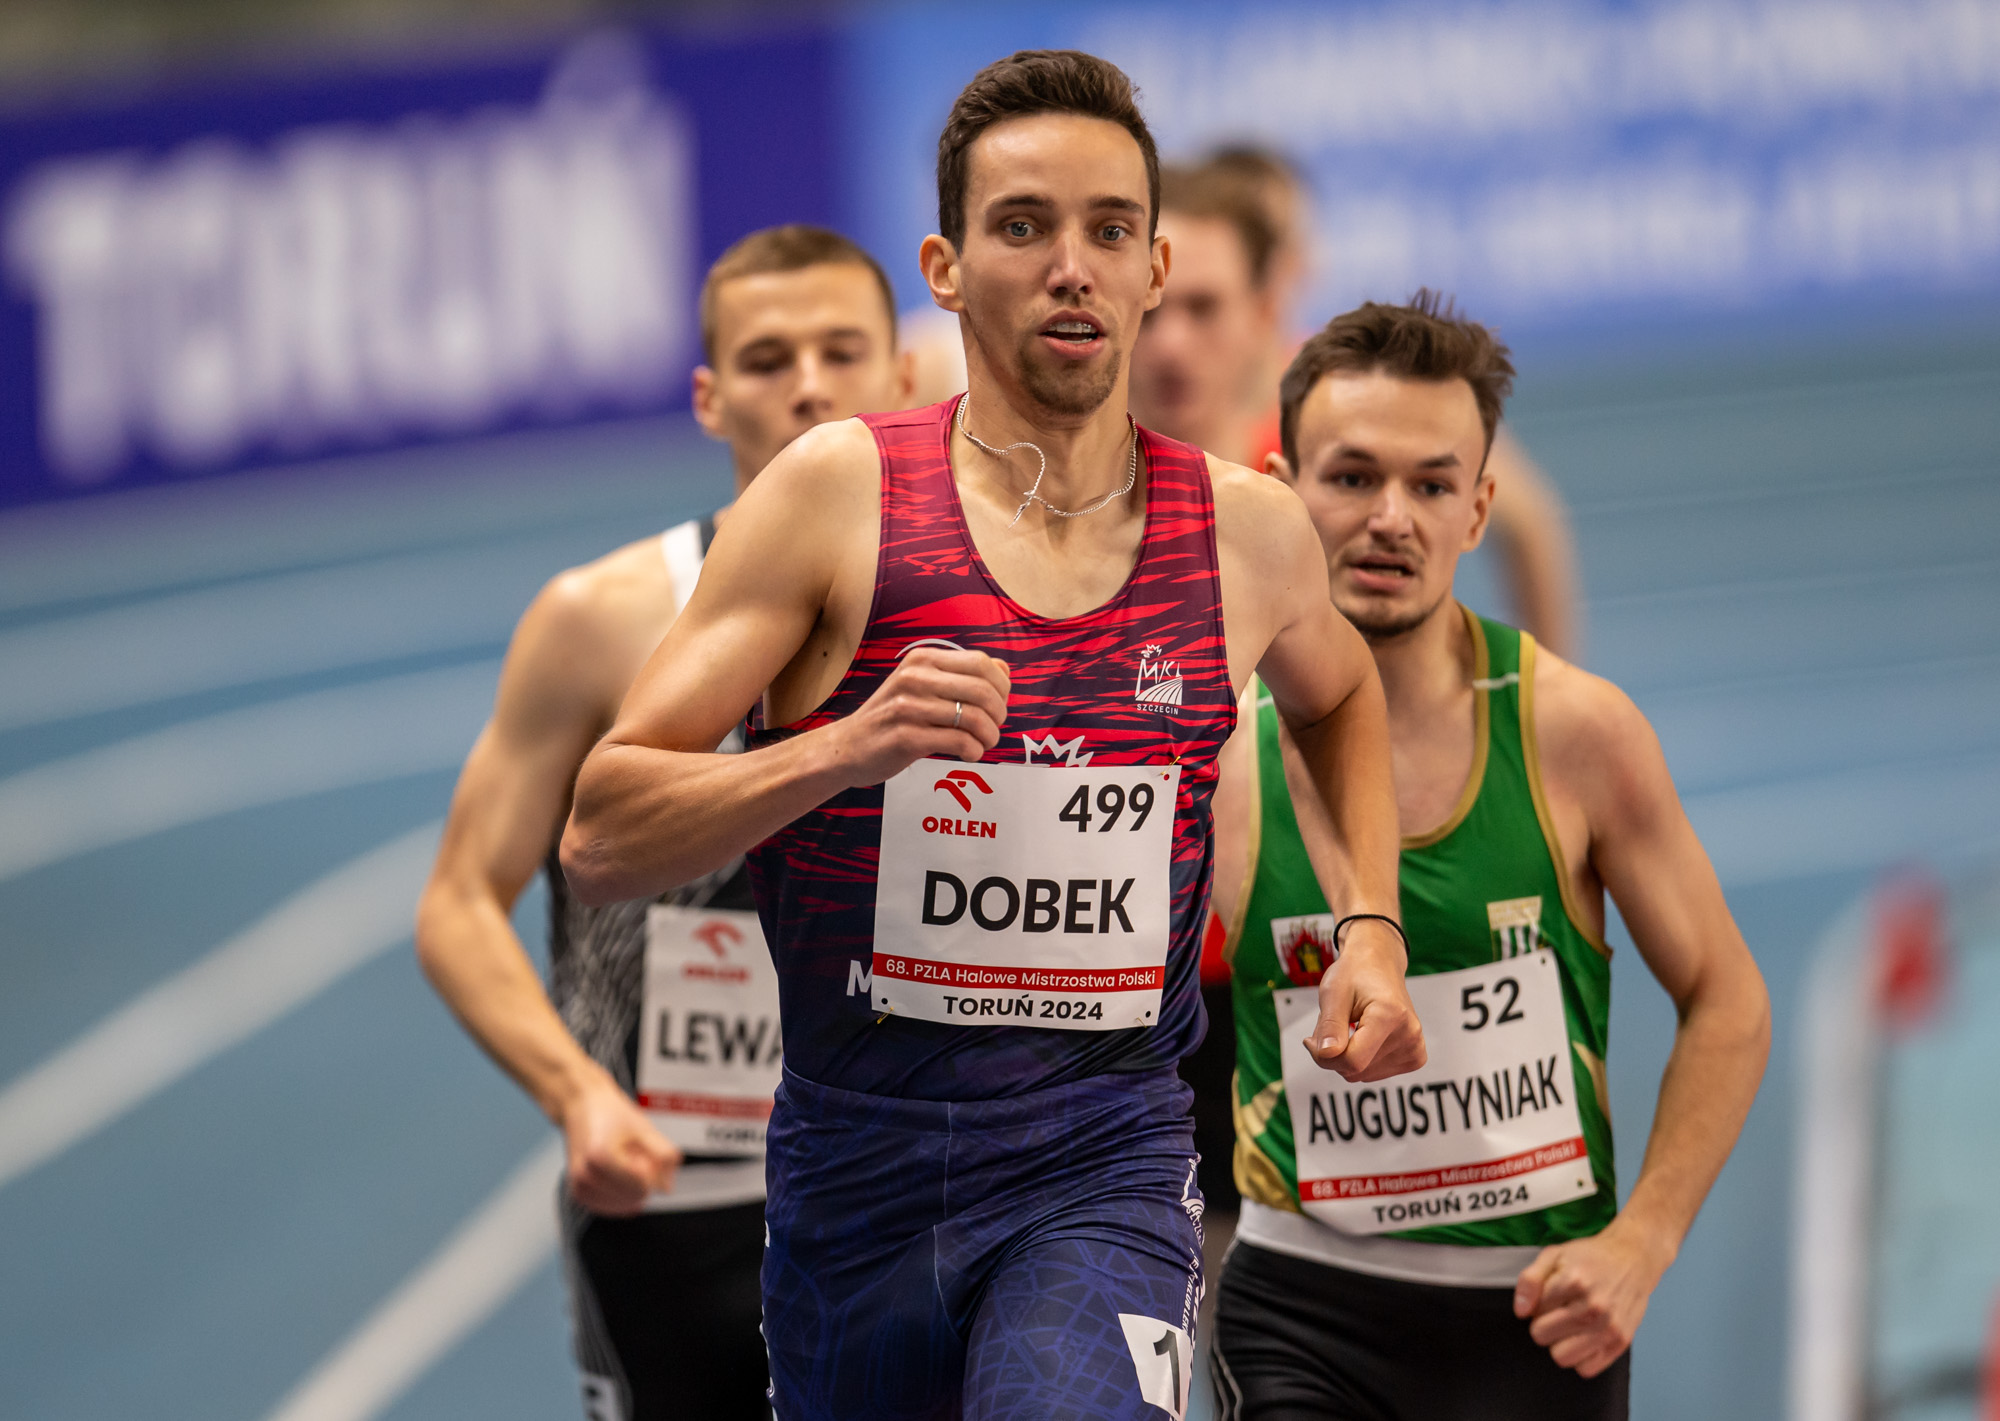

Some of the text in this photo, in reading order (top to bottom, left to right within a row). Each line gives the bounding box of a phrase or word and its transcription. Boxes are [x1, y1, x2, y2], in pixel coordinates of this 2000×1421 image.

[1136, 703, 1179, 715] SZCZECIN
[922, 816, 997, 838] ORLEN
[1059, 783, 1154, 832] 499
[921, 870, 1136, 934] DOBEK
[886, 959, 1155, 987] 68. PZLA Halowe Mistrzostwa Polski
[943, 994, 1103, 1021] TORUŃ 2024
[1461, 977, 1524, 1031] 52
[1308, 1054, 1563, 1145] AUGUSTYNIAK
[1312, 1141, 1578, 1198] 68. PZLA Halowe Mistrzostwa Polski
[1373, 1184, 1530, 1223] TORUŃ 2024
[1153, 1329, 1180, 1416] 1
